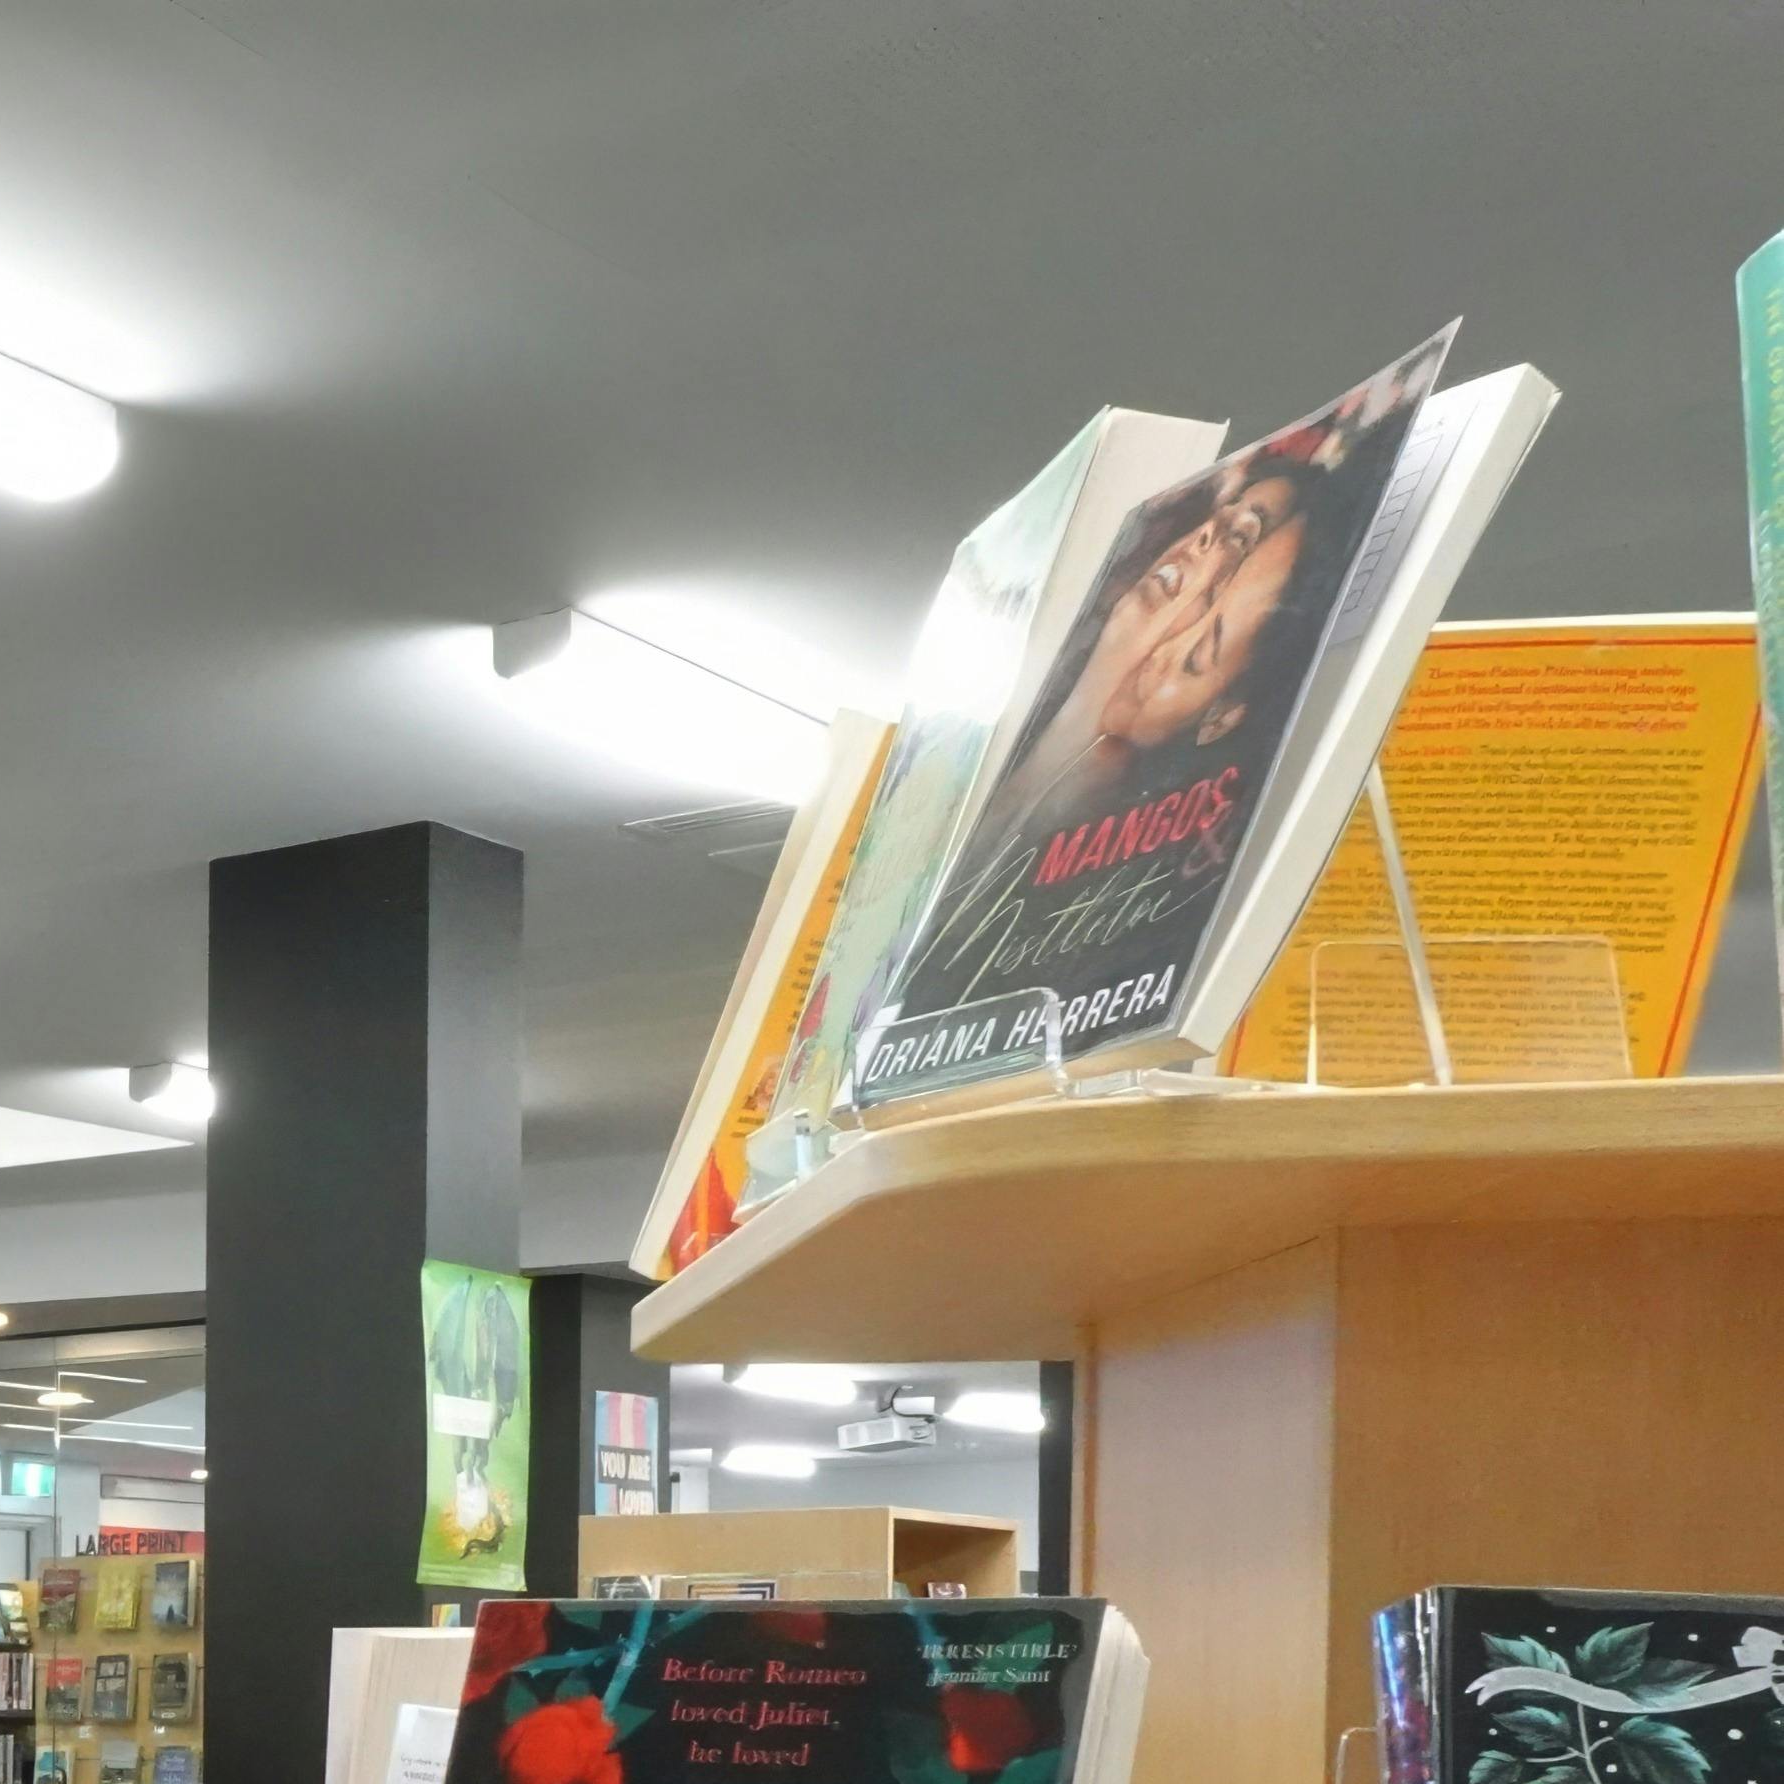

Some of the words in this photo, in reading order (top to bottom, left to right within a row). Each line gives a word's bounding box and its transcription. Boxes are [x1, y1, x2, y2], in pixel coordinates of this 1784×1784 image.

[1034, 767, 1239, 887] MANGOS
[865, 1017, 997, 1083] DRIANA
[1003, 963, 1177, 1051] HERRERA
[601, 1451, 626, 1479] YOU
[76, 1534, 131, 1556] LARGE
[661, 1658, 753, 1683] Before
[764, 1658, 868, 1685] Romeo
[671, 1700, 745, 1725] loved
[689, 1740, 722, 1765] he
[735, 1742, 809, 1767] loved
